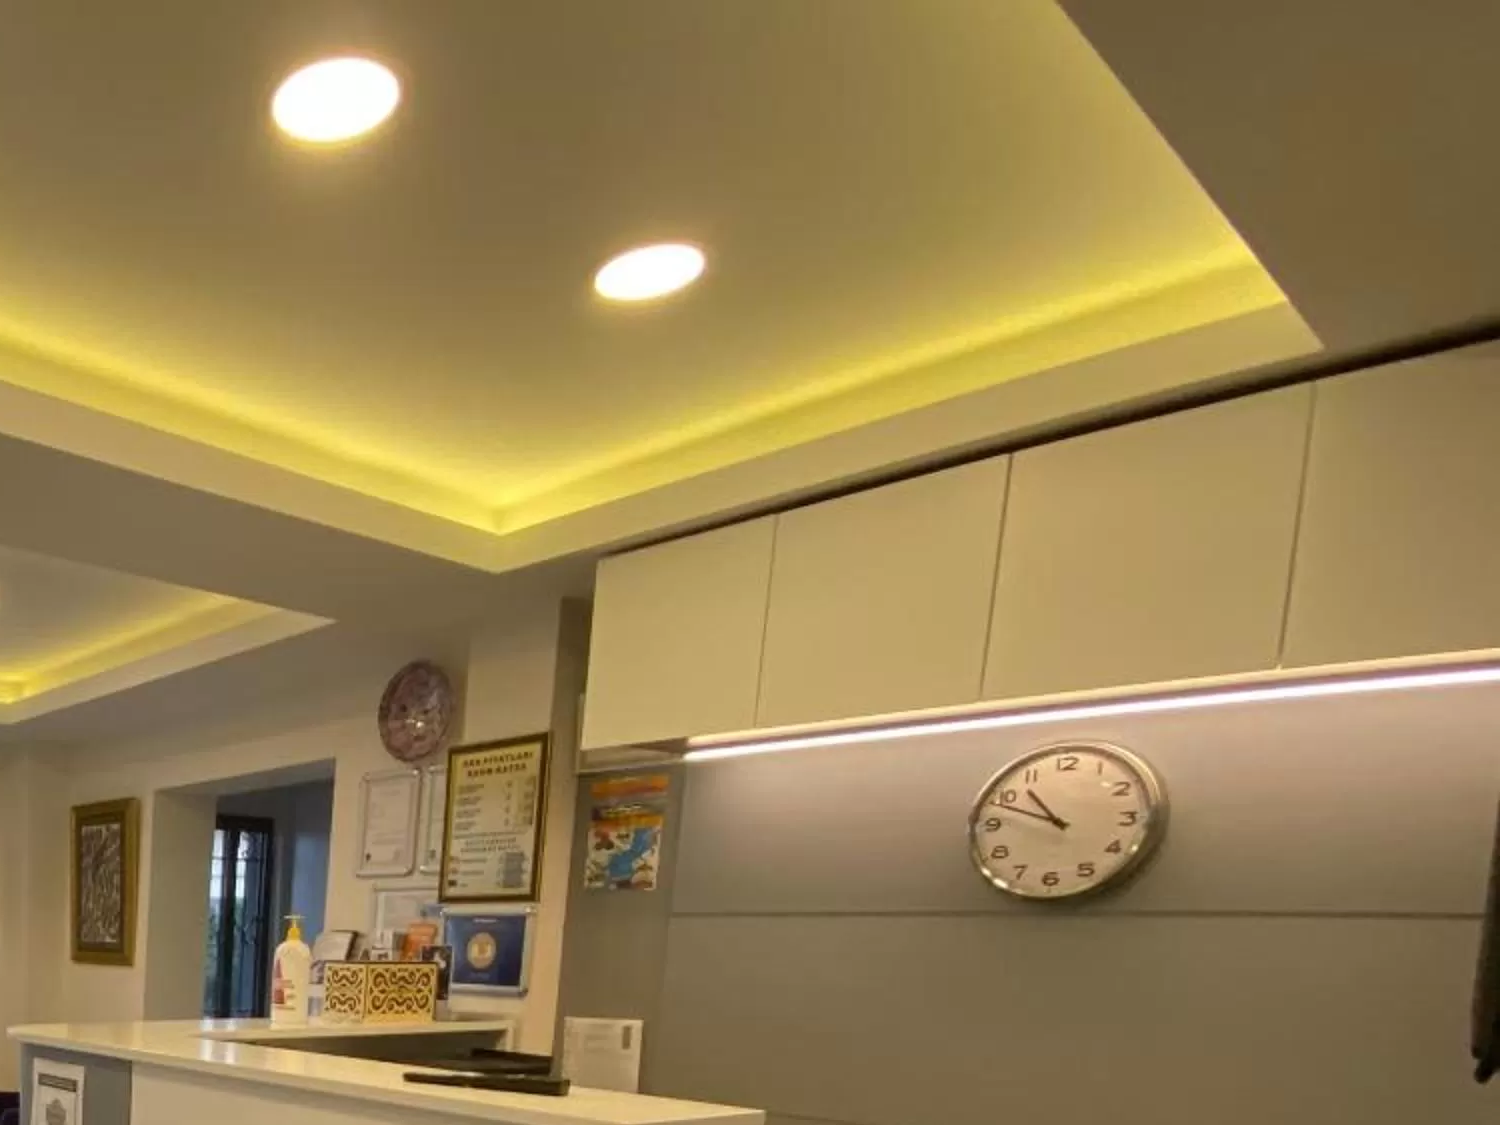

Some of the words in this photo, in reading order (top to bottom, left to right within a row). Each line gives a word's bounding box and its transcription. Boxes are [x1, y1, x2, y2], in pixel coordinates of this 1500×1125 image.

[1057, 756, 1080, 772] 12
[1097, 761, 1104, 775] 1
[1025, 769, 1038, 784] 11
[999, 789, 1018, 804] 10
[1112, 781, 1131, 797] 2
[985, 817, 1002, 832] 9
[1119, 811, 1137, 827] 3
[991, 845, 1009, 859] 8
[1104, 839, 1122, 854] 4
[1013, 865, 1028, 881] 7
[1077, 862, 1095, 878] 5
[1042, 871, 1060, 887] 6
